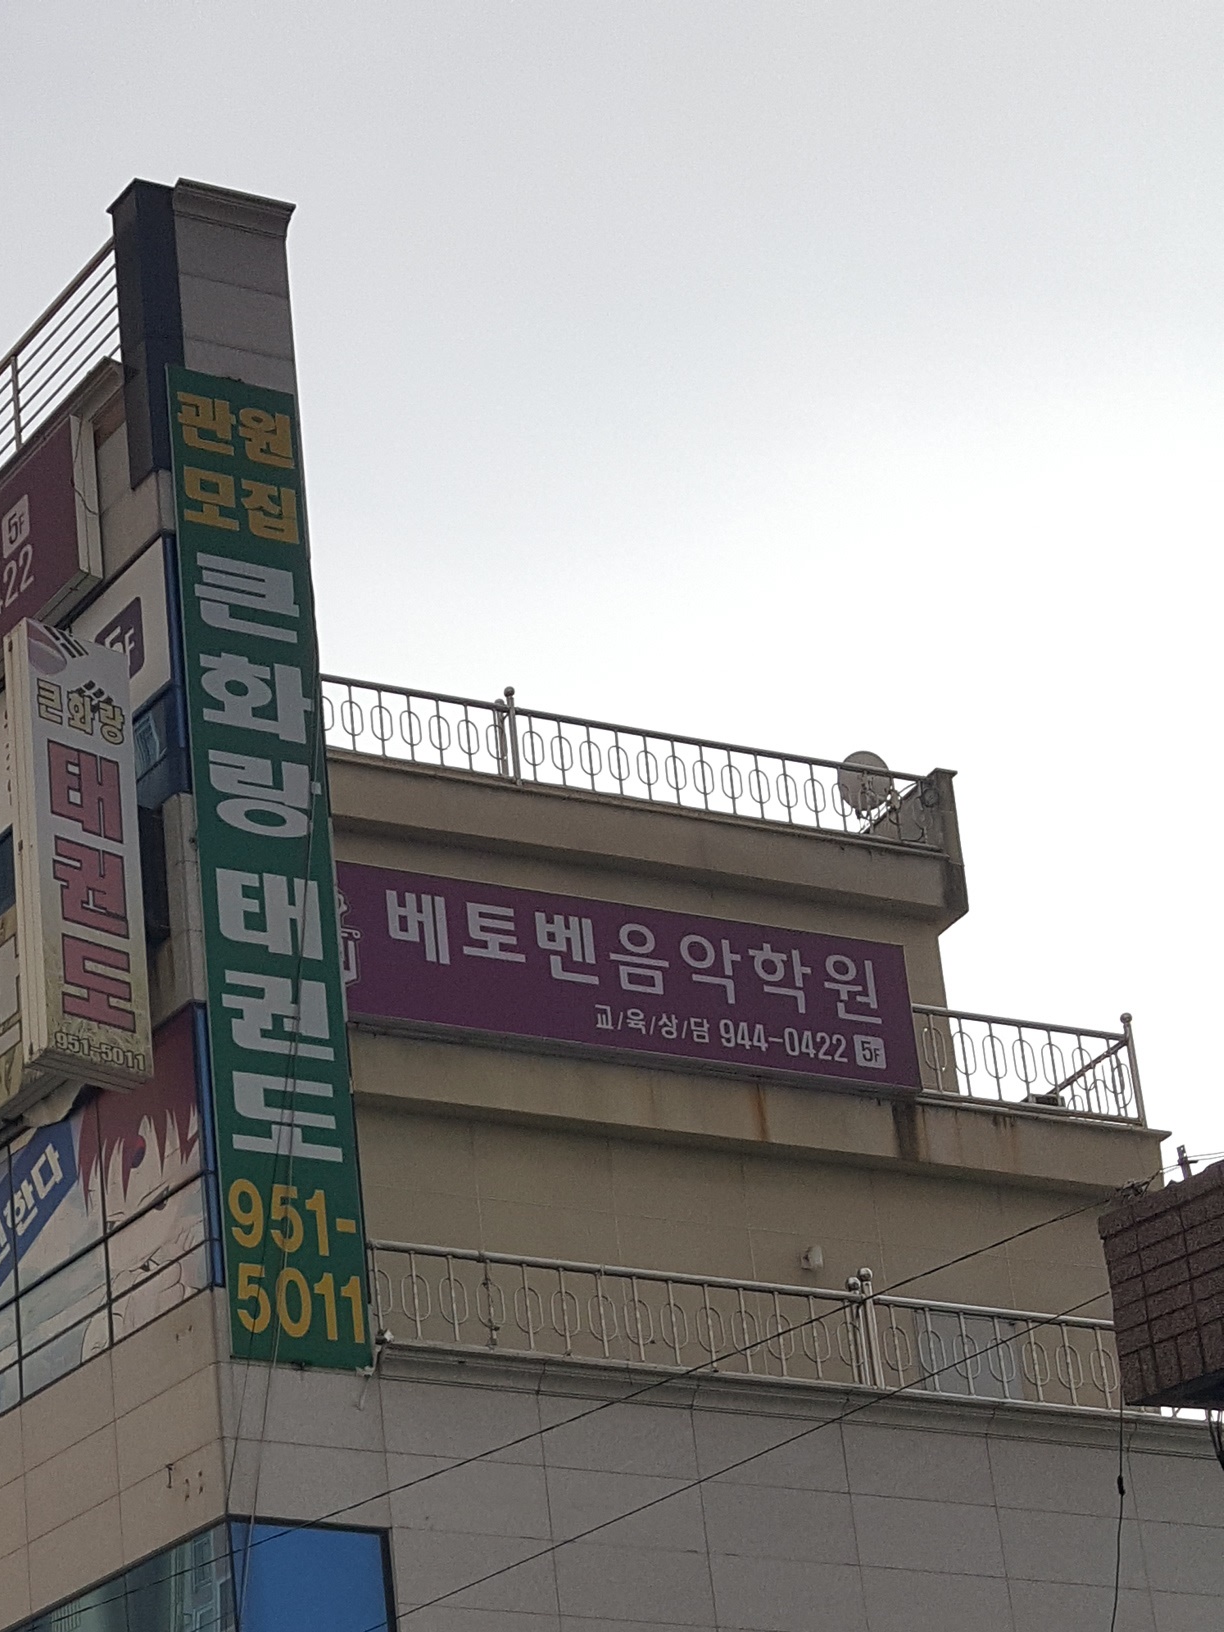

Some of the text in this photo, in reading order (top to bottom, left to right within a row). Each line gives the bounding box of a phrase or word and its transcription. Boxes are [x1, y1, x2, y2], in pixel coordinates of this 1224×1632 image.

[177, 392, 295, 468] 관원
[8, 513, 25, 545] 5F
[183, 465, 300, 545] 모집
[37, 678, 125, 745] 큰화랑
[47, 739, 137, 1034] 태권도
[195, 552, 344, 1163] 큰화랑 태권도
[55, 1031, 146, 1071] 951-5011
[595, 1003, 882, 1064] 교/육/상/담 944-0422 5F
[228, 1178, 358, 1257] 951-
[237, 1264, 366, 1345] 5011
